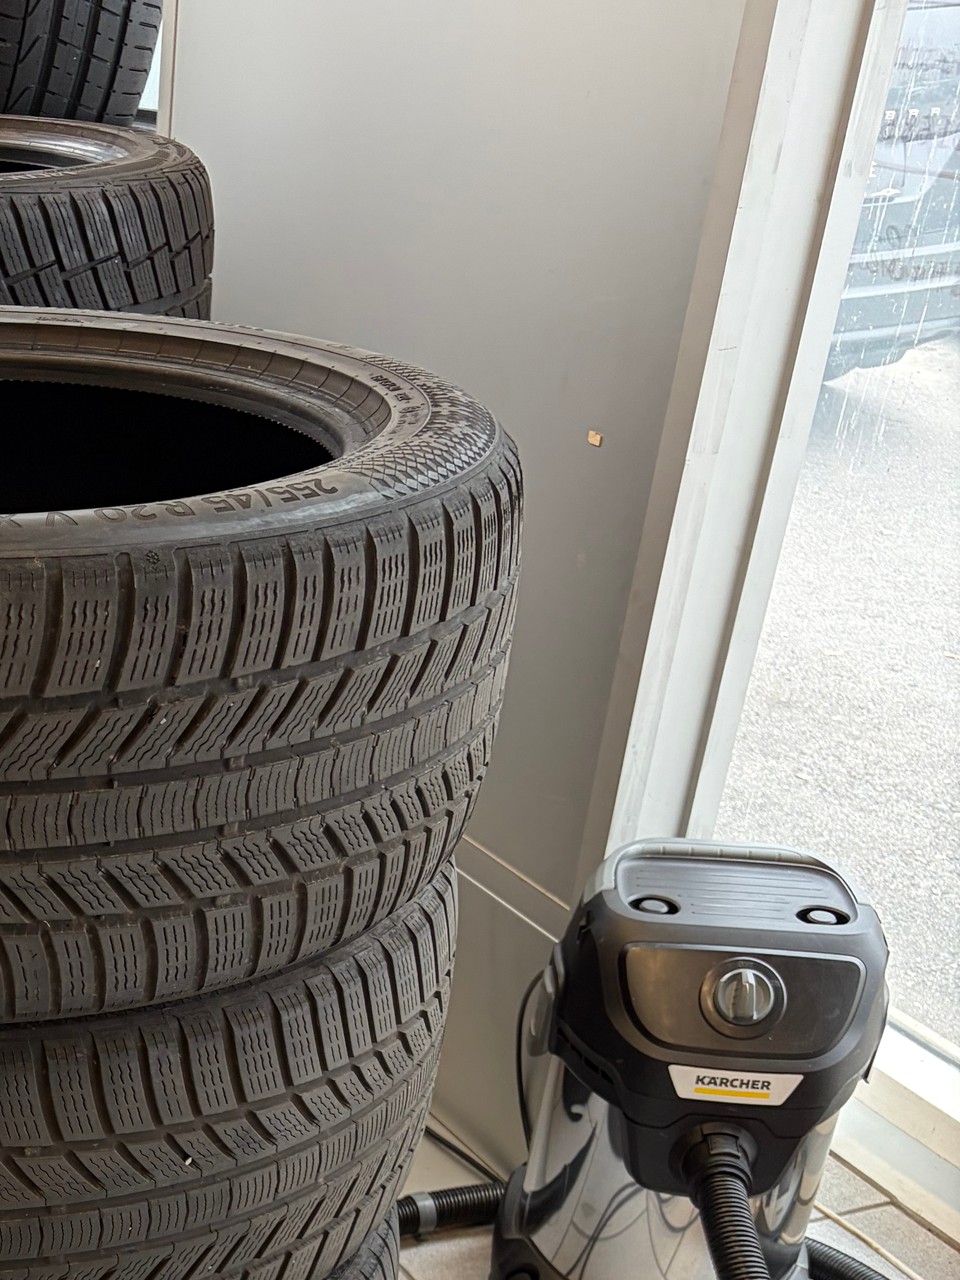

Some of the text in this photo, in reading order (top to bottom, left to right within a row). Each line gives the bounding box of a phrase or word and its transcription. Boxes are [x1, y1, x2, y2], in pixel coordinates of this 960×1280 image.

[201, 478, 338, 513] 255/45
[93, 504, 157, 523] 20
[157, 501, 196, 516] R
[695, 1075, 772, 1090] KÄRCHER
